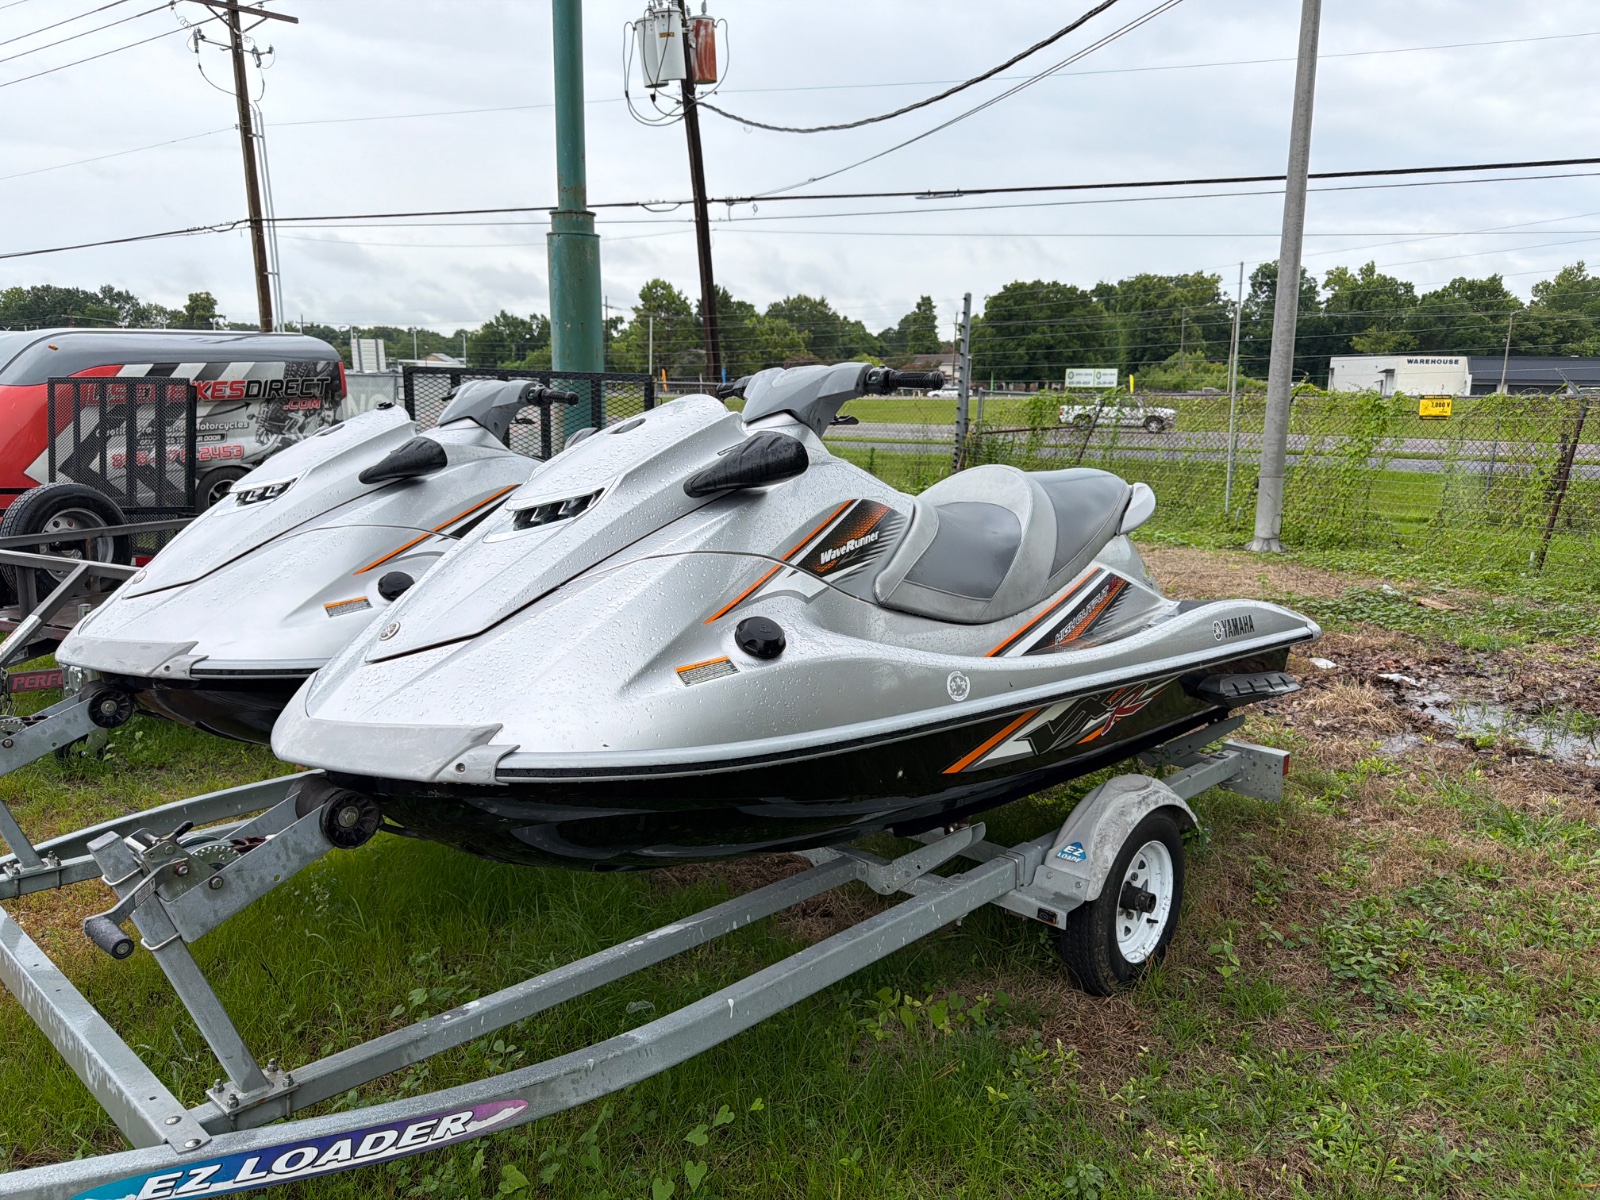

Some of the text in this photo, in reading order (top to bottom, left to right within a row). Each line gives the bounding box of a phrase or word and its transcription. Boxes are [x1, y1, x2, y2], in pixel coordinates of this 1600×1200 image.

[283, 399, 321, 410] .COM
[821, 531, 879, 565] WaveRunner
[1221, 614, 1255, 639] YAMAHA
[1063, 845, 1084, 857] EZ
[135, 1109, 475, 1200] EZ LOADER
